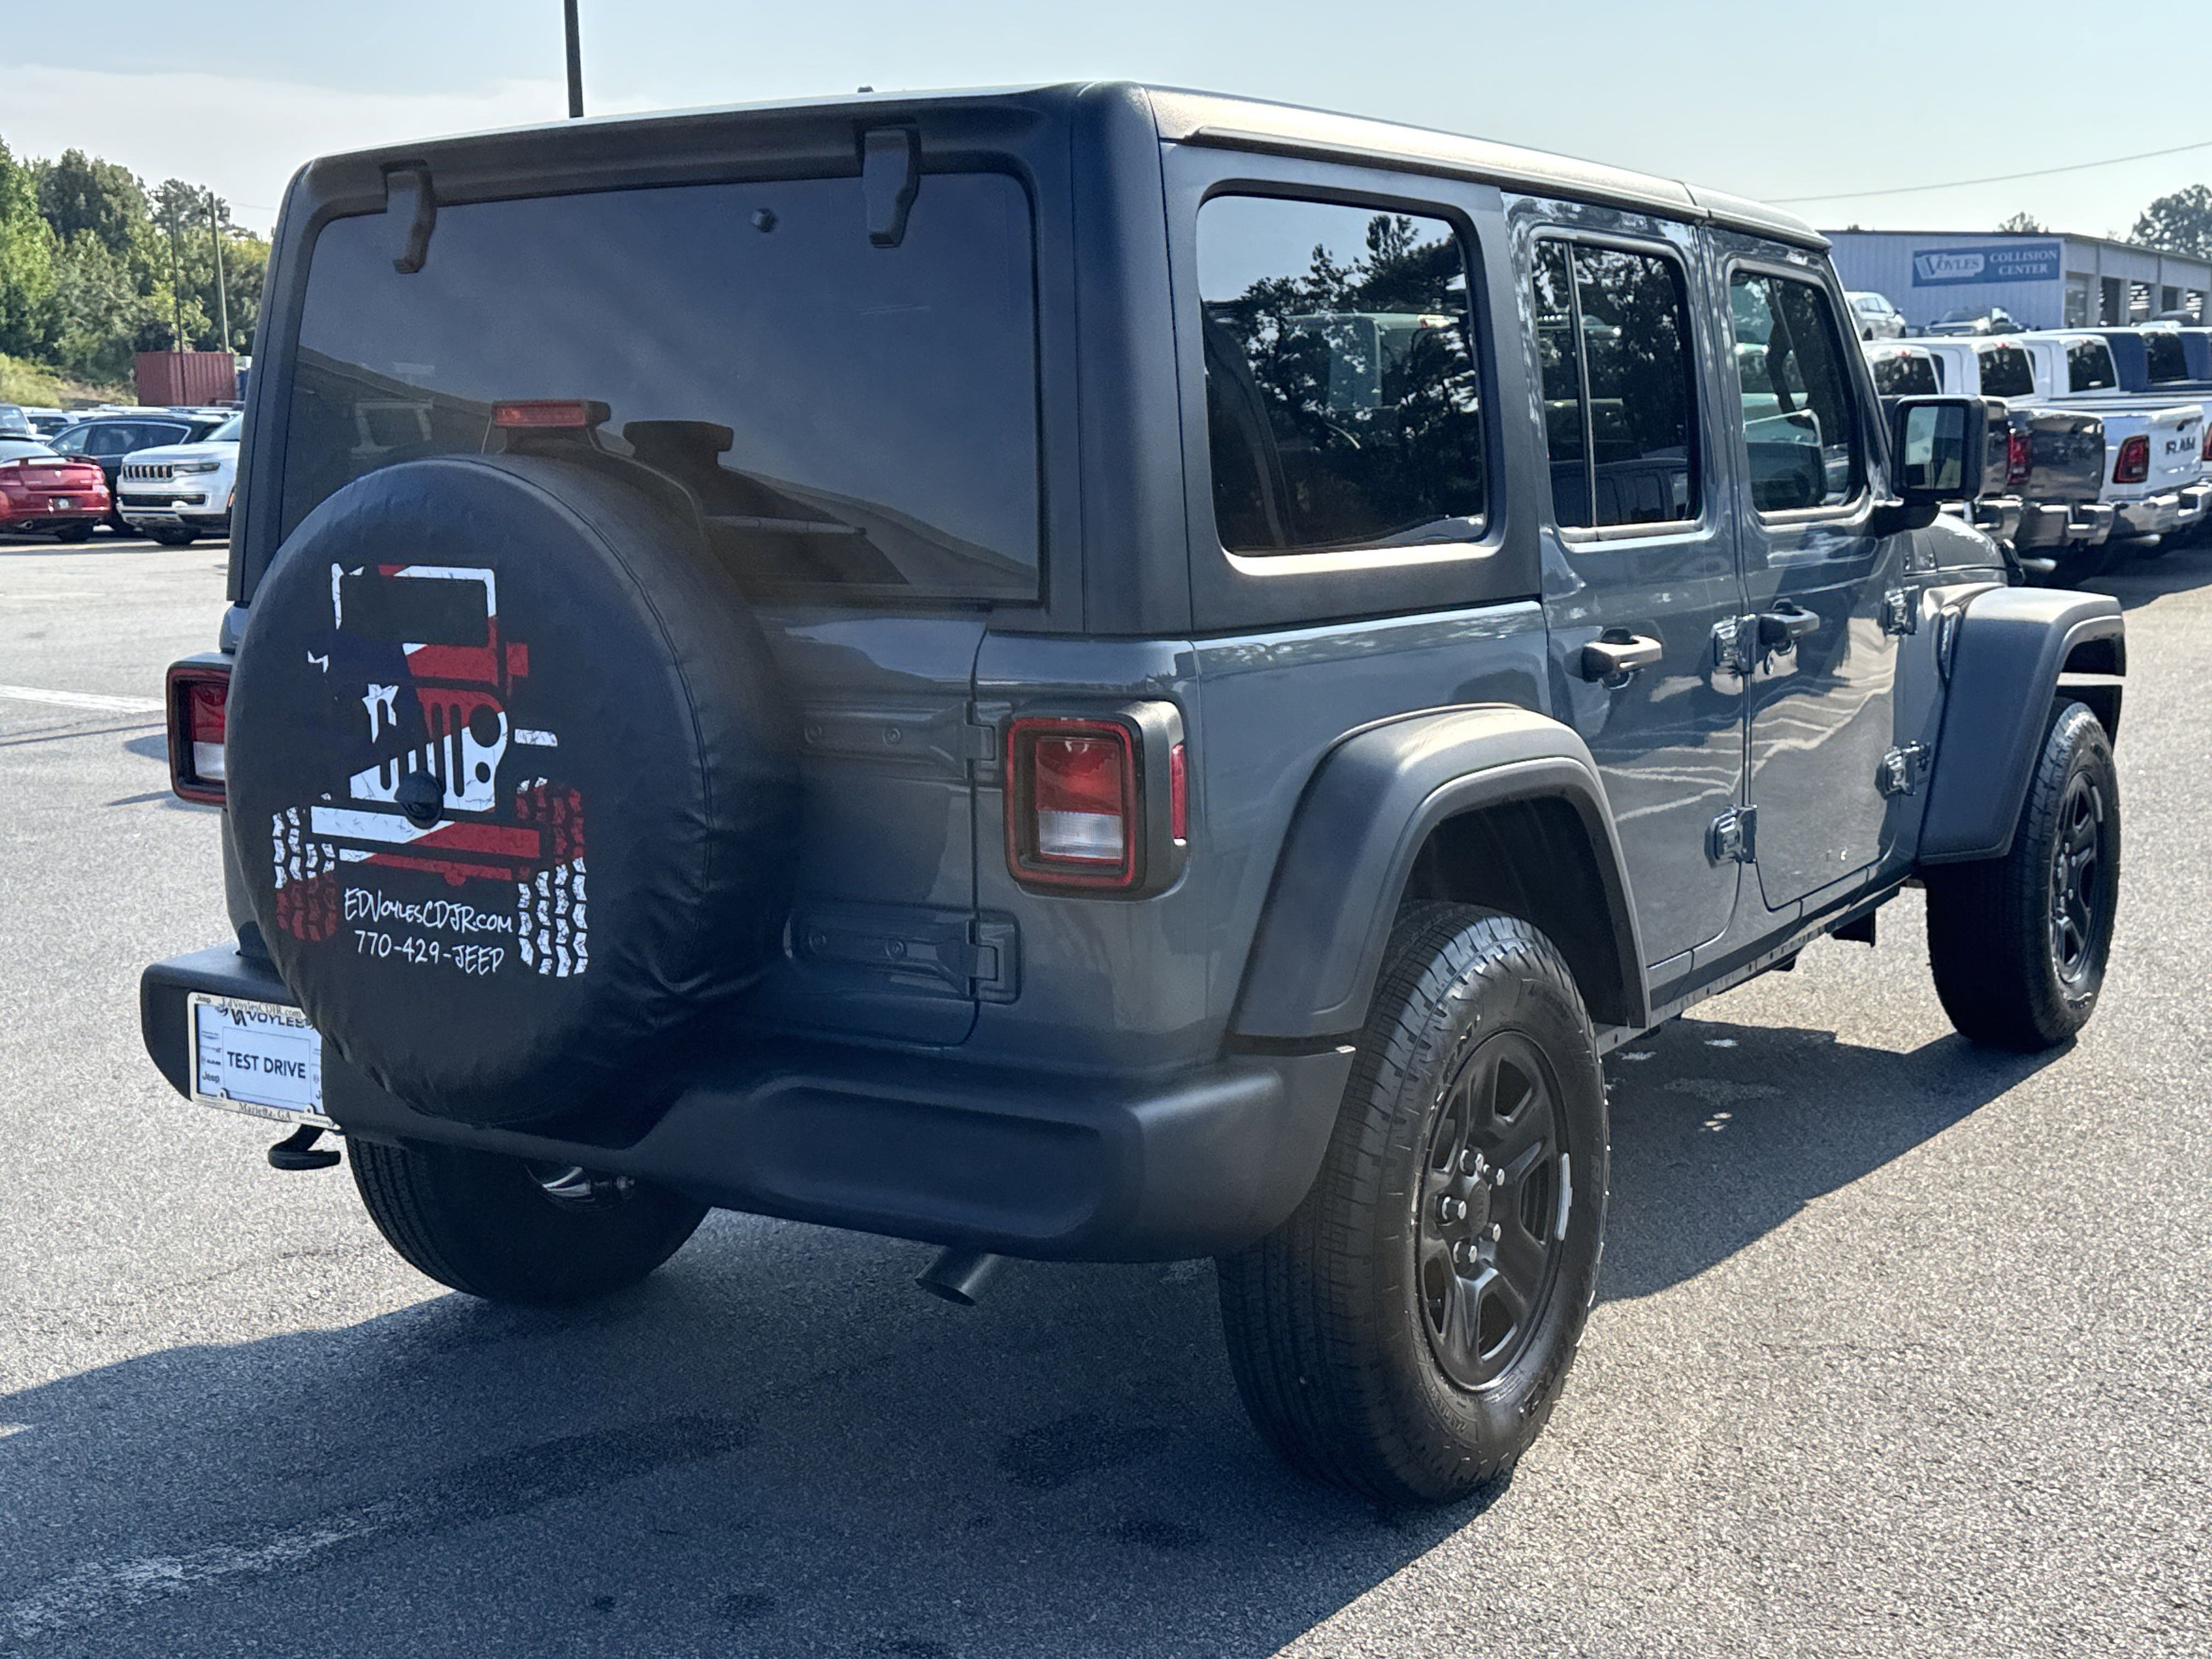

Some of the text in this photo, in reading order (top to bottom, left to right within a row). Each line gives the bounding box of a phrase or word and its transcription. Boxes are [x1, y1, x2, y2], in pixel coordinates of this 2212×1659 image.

[1925, 254, 1979, 275] VOYLES
[1989, 250, 2057, 263] COLLISION
[1999, 263, 2047, 275] CENTER
[2166, 437, 2196, 455] RAM
[354, 930, 505, 976] 770-429-JEEP
[227, 1051, 306, 1079] TEST DRIVE
[278, 1108, 291, 1121] GA
